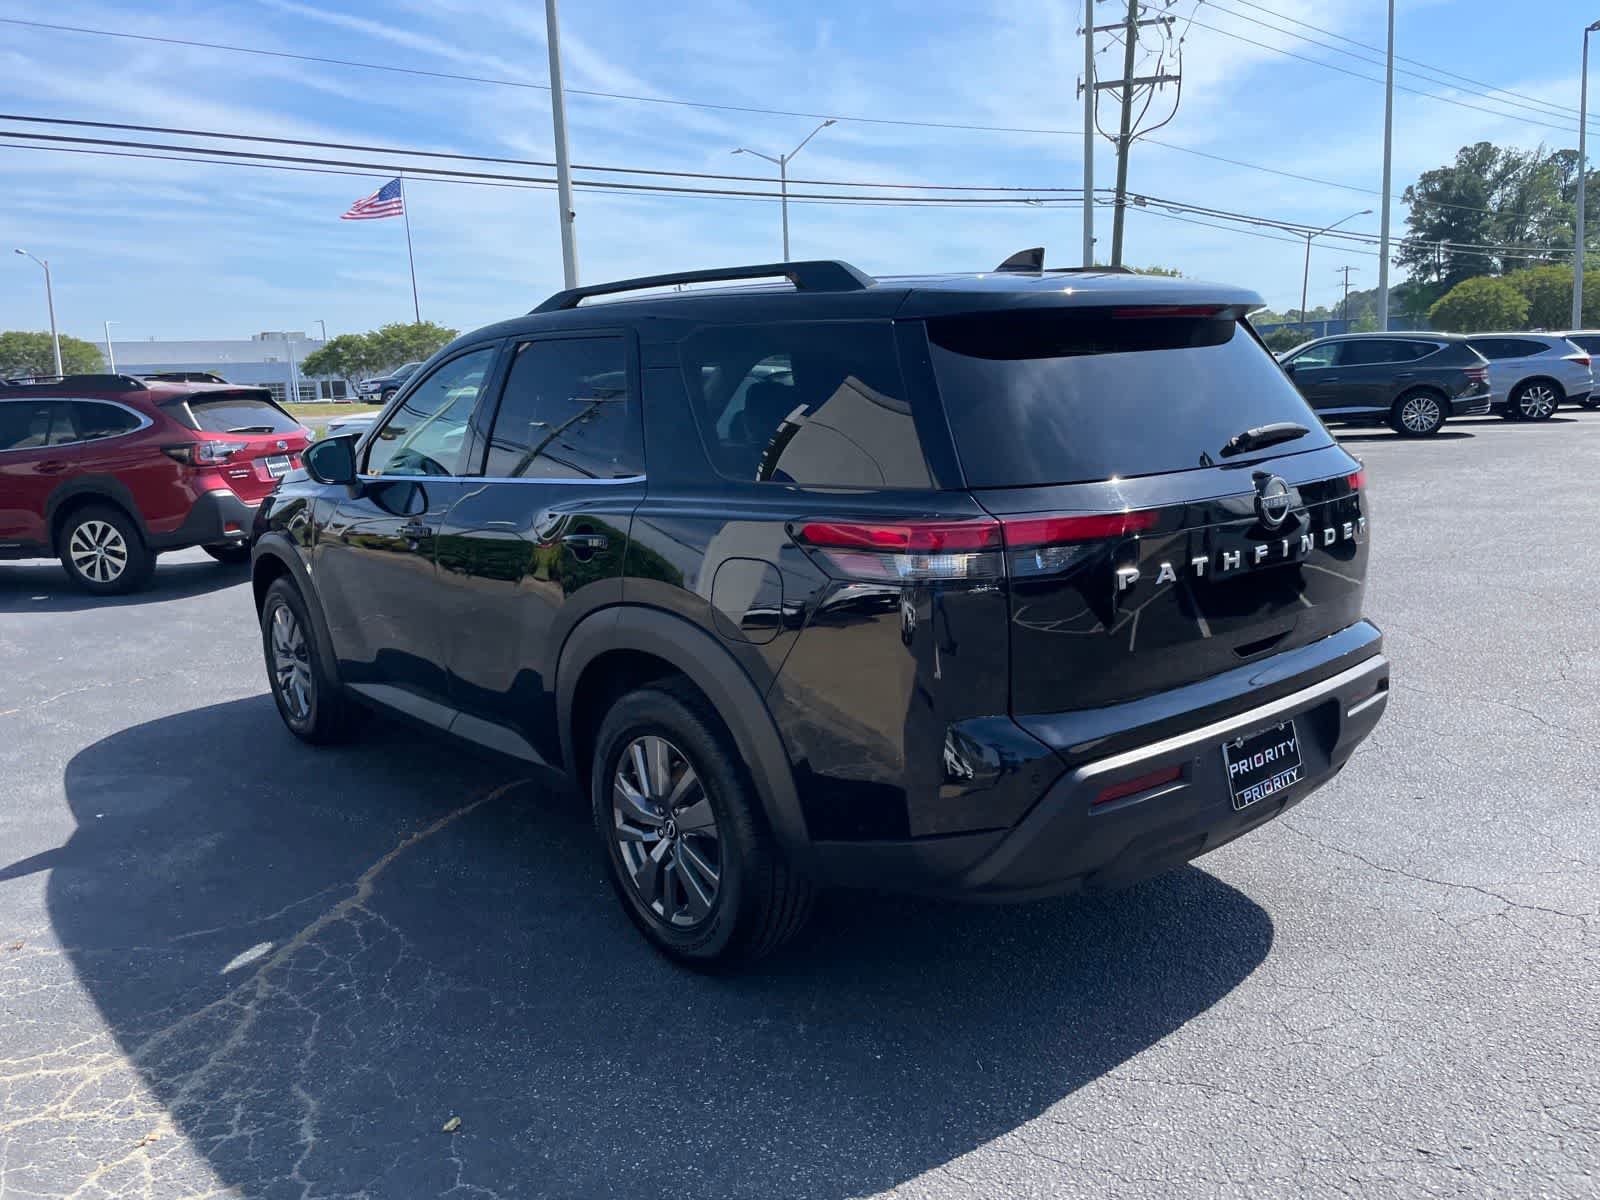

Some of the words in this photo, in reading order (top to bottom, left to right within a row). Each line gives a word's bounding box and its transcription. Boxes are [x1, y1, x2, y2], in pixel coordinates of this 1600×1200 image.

[1116, 517, 1366, 591] PATHFINDER
[1229, 738, 1295, 779] PRIORITY
[1243, 768, 1298, 805] PRIORITY
